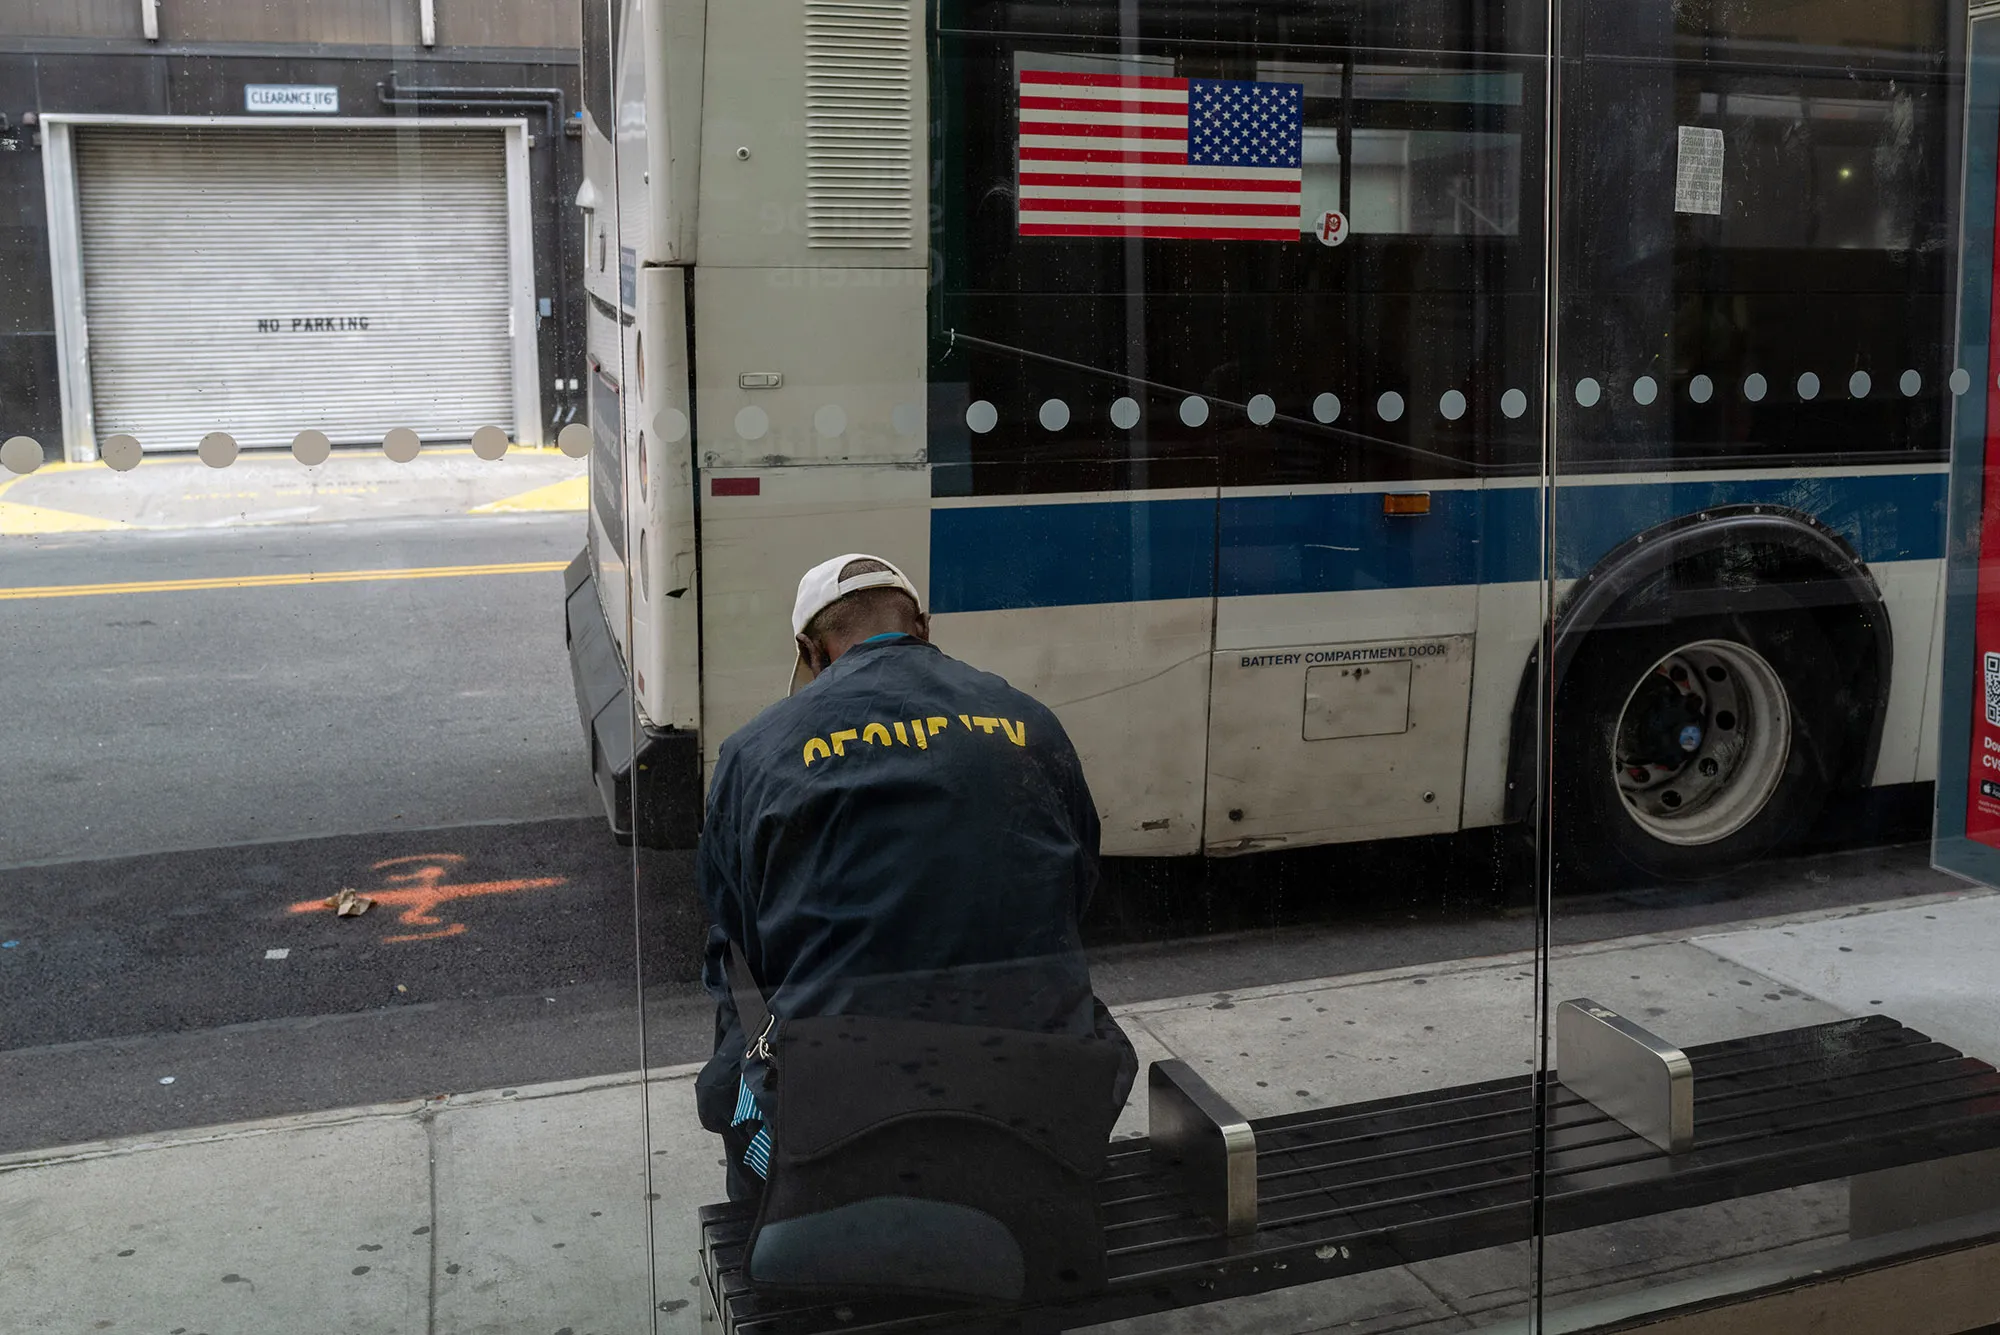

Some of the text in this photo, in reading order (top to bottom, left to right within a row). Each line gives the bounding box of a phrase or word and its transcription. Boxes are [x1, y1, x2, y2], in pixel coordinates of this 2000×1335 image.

[251, 91, 312, 105] CLEARANCE
[258, 317, 369, 333] NO PARKING
[1241, 644, 1446, 668] BATTERY COMPARTMENT DOOR
[803, 714, 1026, 768] SECUTY
